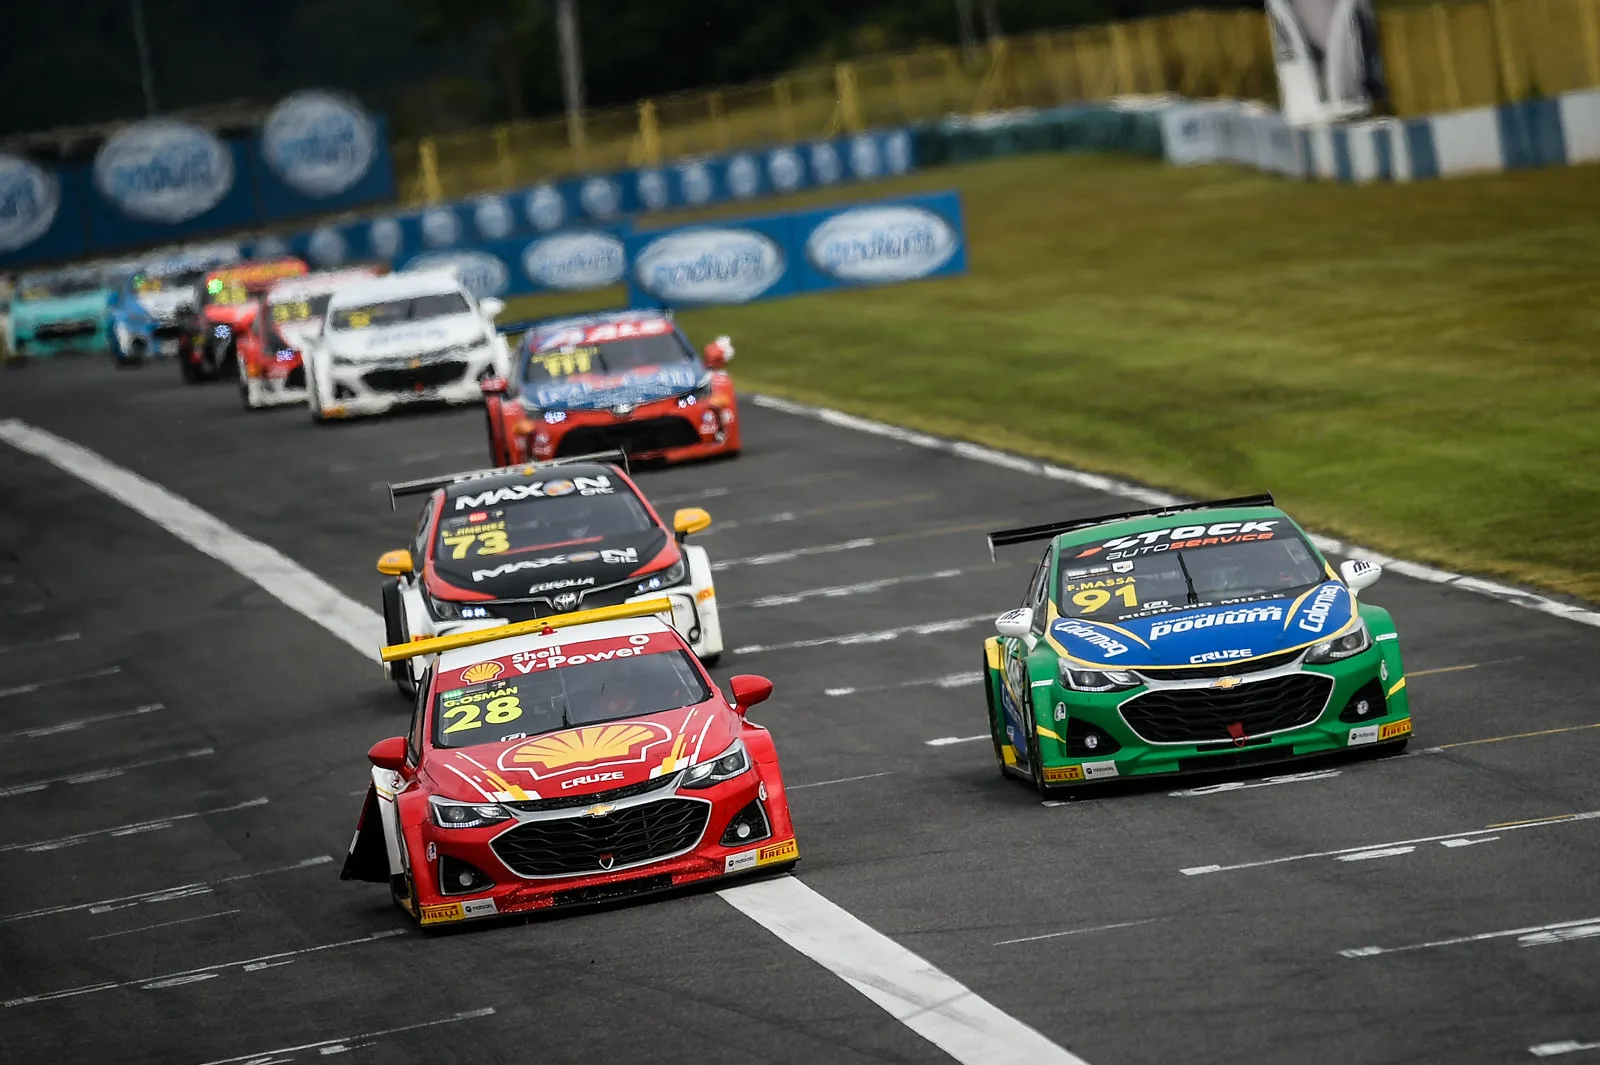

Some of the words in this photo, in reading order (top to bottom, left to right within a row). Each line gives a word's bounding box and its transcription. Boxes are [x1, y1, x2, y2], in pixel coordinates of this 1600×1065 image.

[455, 475, 612, 510] MAXON
[443, 530, 511, 560] 73
[1102, 520, 1280, 551] STOCK
[471, 547, 639, 582] MAXON
[1067, 576, 1137, 592] F.MASSA
[1072, 584, 1138, 614] 91
[1150, 605, 1283, 641] podium
[512, 645, 562, 664] Shell
[514, 645, 645, 674] V-Power
[1189, 648, 1253, 664] CRUZE
[443, 686, 519, 708] G.OSMAN
[443, 696, 523, 734] 28
[560, 770, 625, 790] CRUZE
[760, 840, 794, 860] PIRELLI
